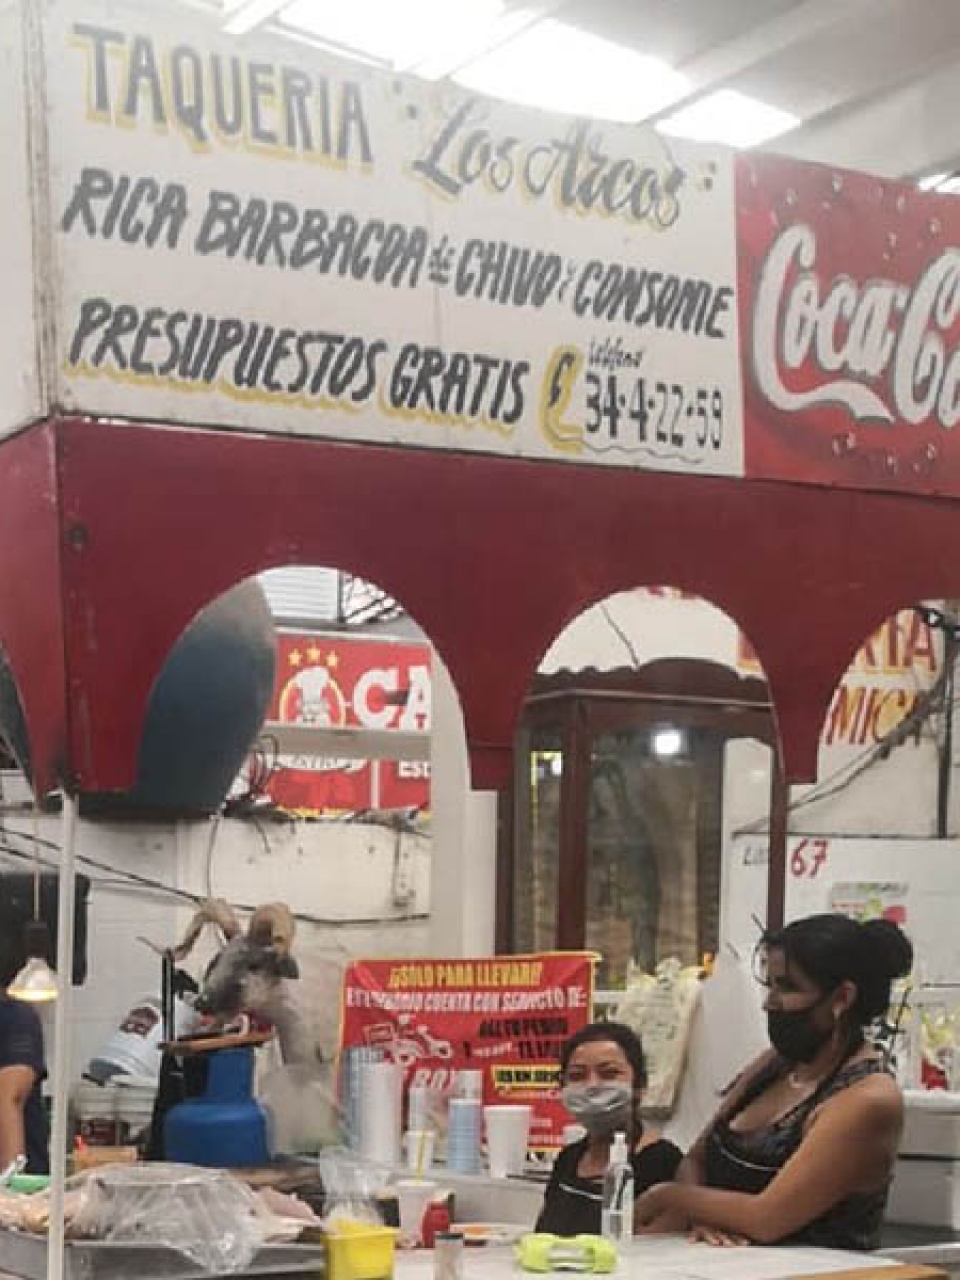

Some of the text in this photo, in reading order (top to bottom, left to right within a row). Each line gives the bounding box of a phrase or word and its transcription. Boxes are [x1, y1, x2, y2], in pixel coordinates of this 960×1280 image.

[71, 23, 373, 165] TAQUERIA
[62, 168, 188, 249] RICA
[195, 191, 428, 288] BARBACOA
[455, 238, 561, 308] CHIVO
[574, 259, 734, 338] CONSOME
[69, 298, 530, 424] PRESUPUESTOS GRATIS
[790, 836, 829, 879] 67
